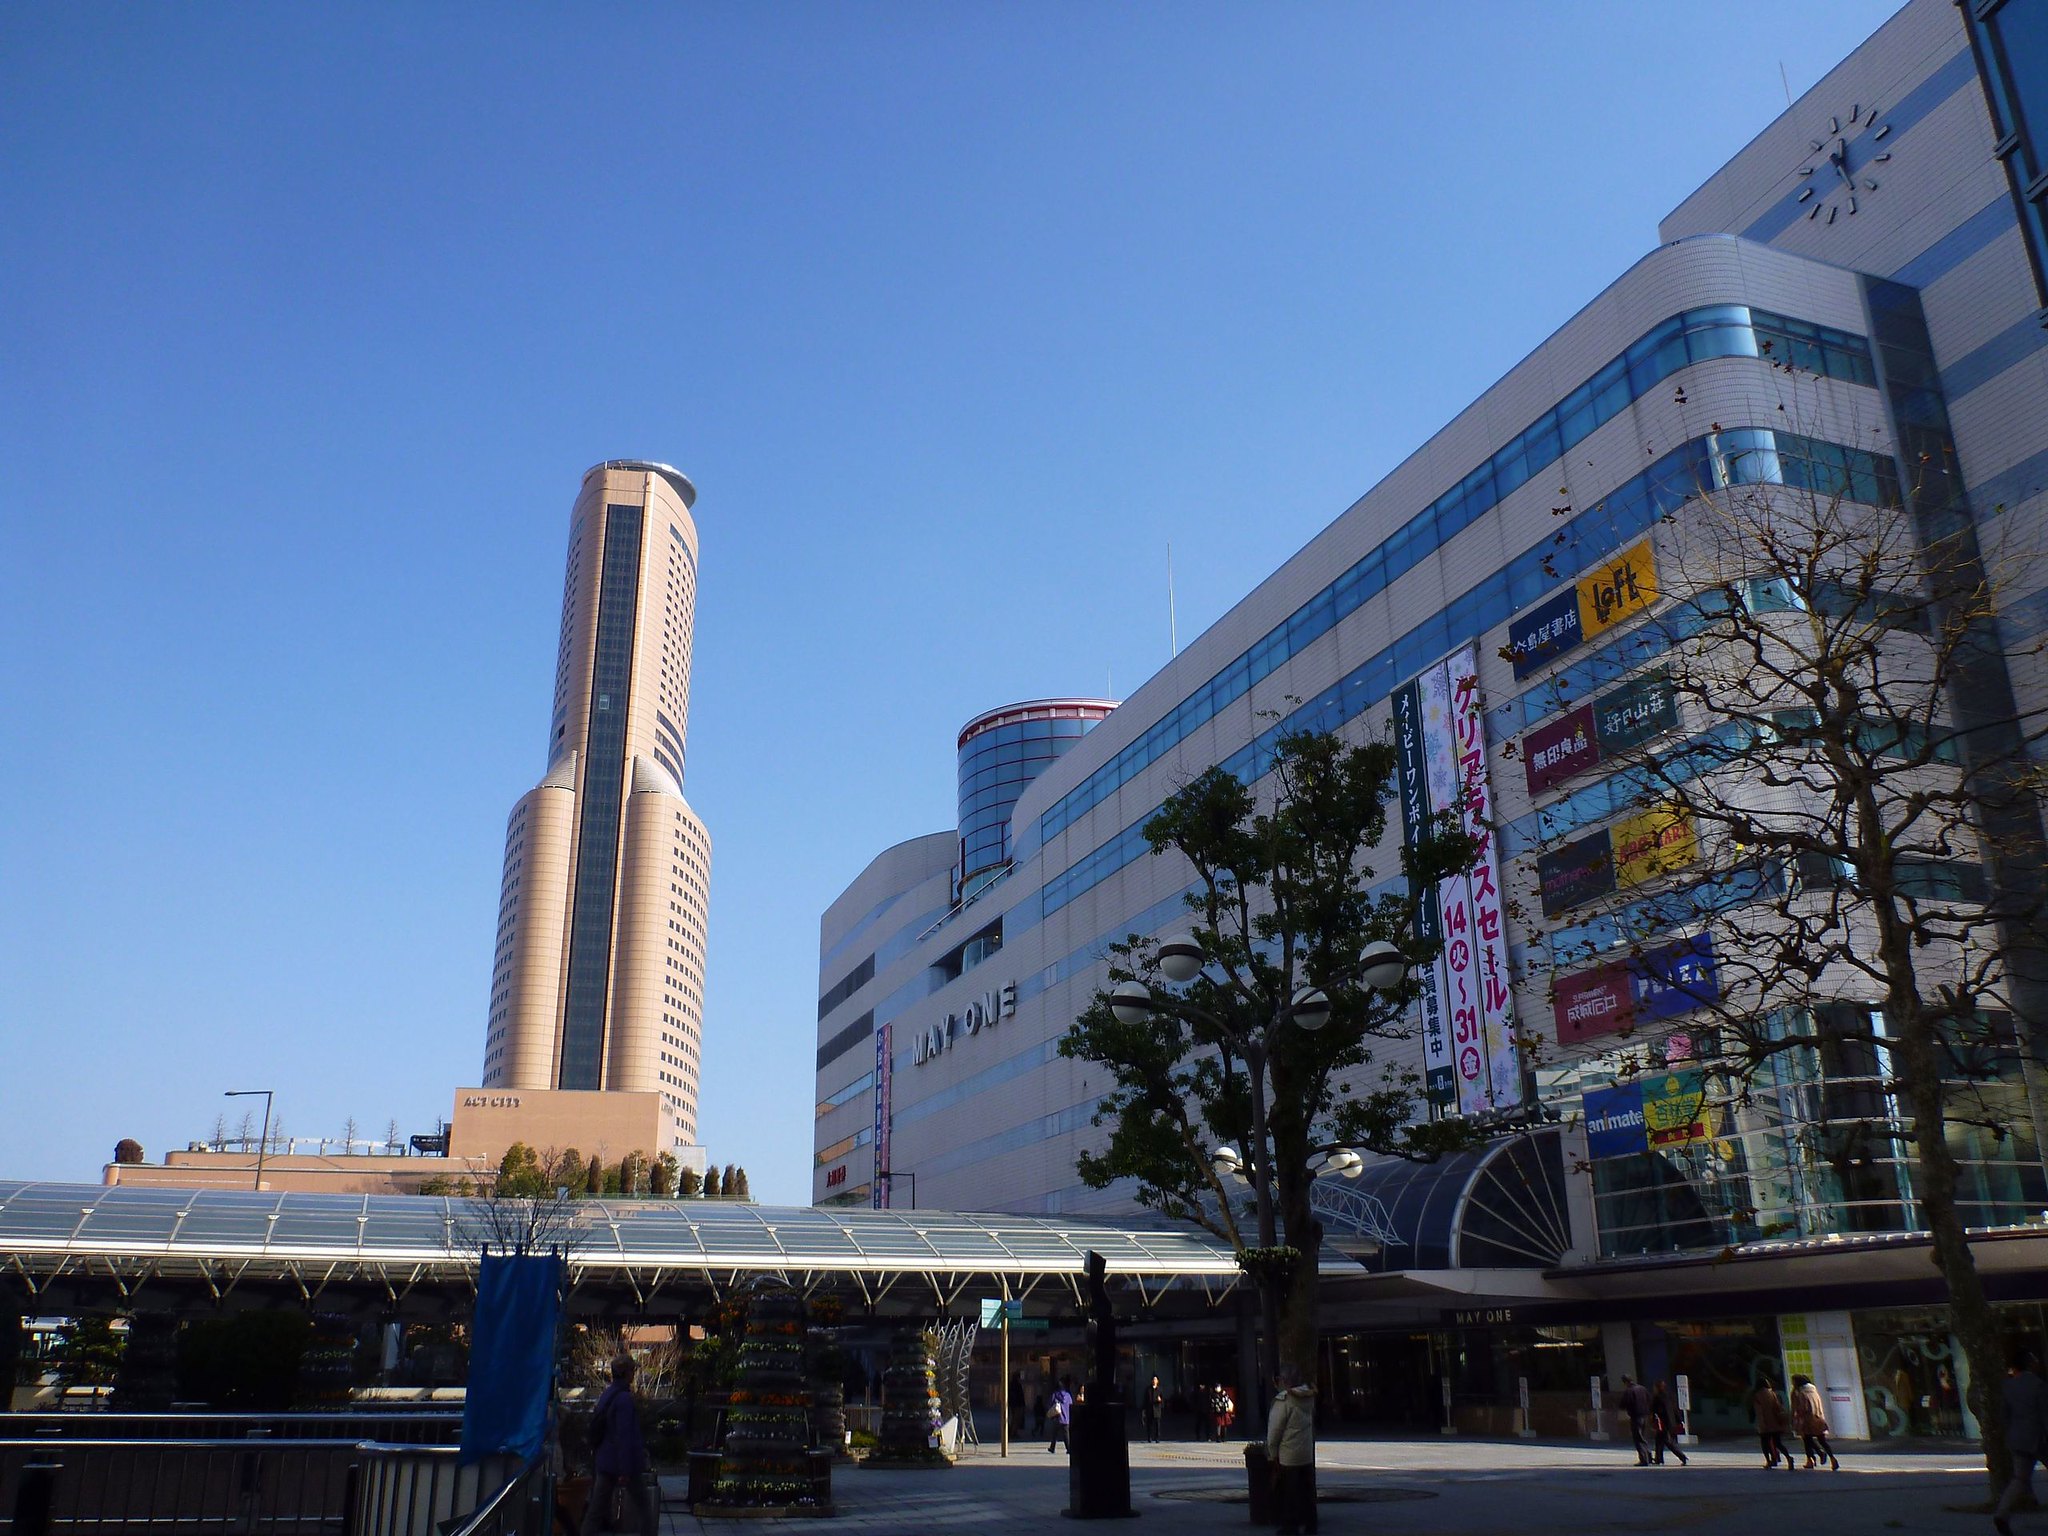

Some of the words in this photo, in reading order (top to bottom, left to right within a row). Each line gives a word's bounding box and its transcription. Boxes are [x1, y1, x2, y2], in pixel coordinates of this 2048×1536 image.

[1604, 691, 1667, 736] 好日山荘
[1532, 734, 1588, 773] 無印良品
[912, 1013, 954, 1066] MAY
[964, 979, 1016, 1036] ONE
[1566, 994, 1618, 1023] 成城石井
[464, 1096, 487, 1108] ACT
[490, 1096, 521, 1108] CITY
[1587, 1108, 1644, 1134] animate
[1456, 1311, 1480, 1325] MAY
[1486, 1309, 1512, 1323] ONE
